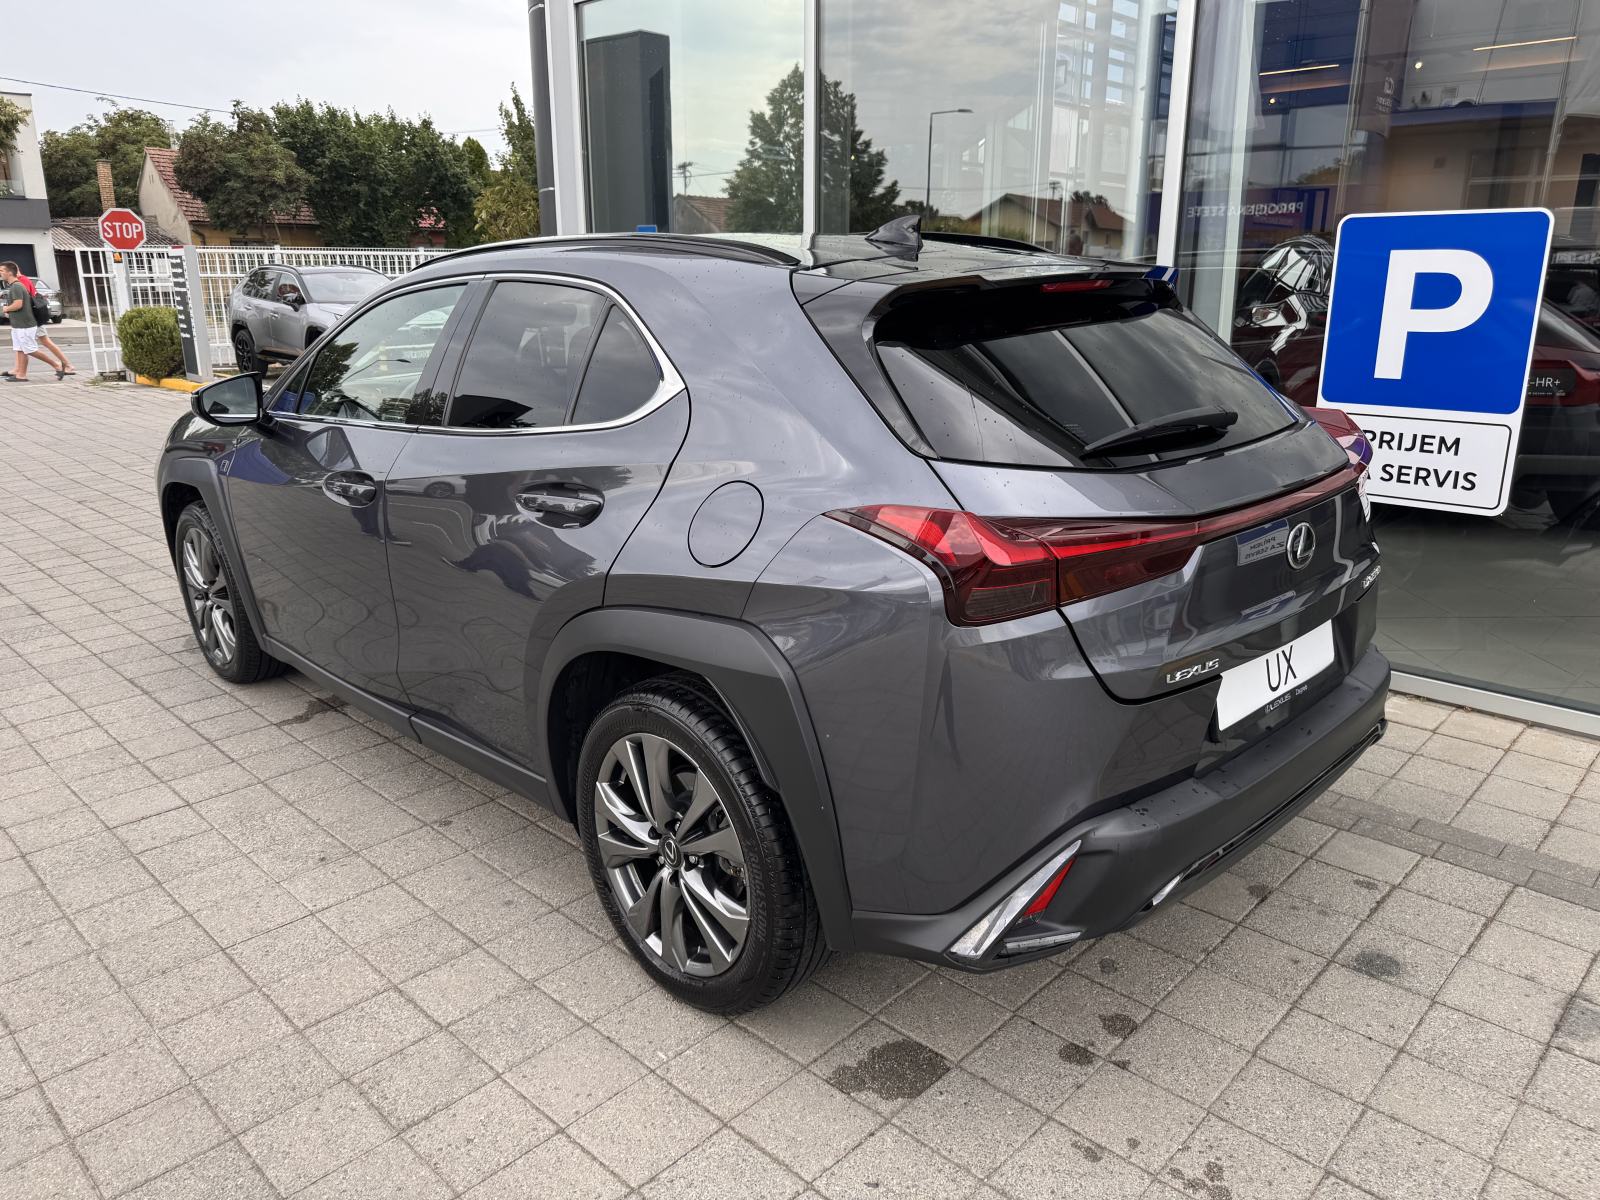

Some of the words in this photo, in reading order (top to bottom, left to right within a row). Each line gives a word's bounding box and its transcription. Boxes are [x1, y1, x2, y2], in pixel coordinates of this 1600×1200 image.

[103, 221, 142, 239] STOP
[1374, 249, 1494, 380] P
[1379, 463, 1478, 491] SERVIS
[1166, 658, 1220, 684] LEXUS
[1265, 644, 1298, 692] UX
